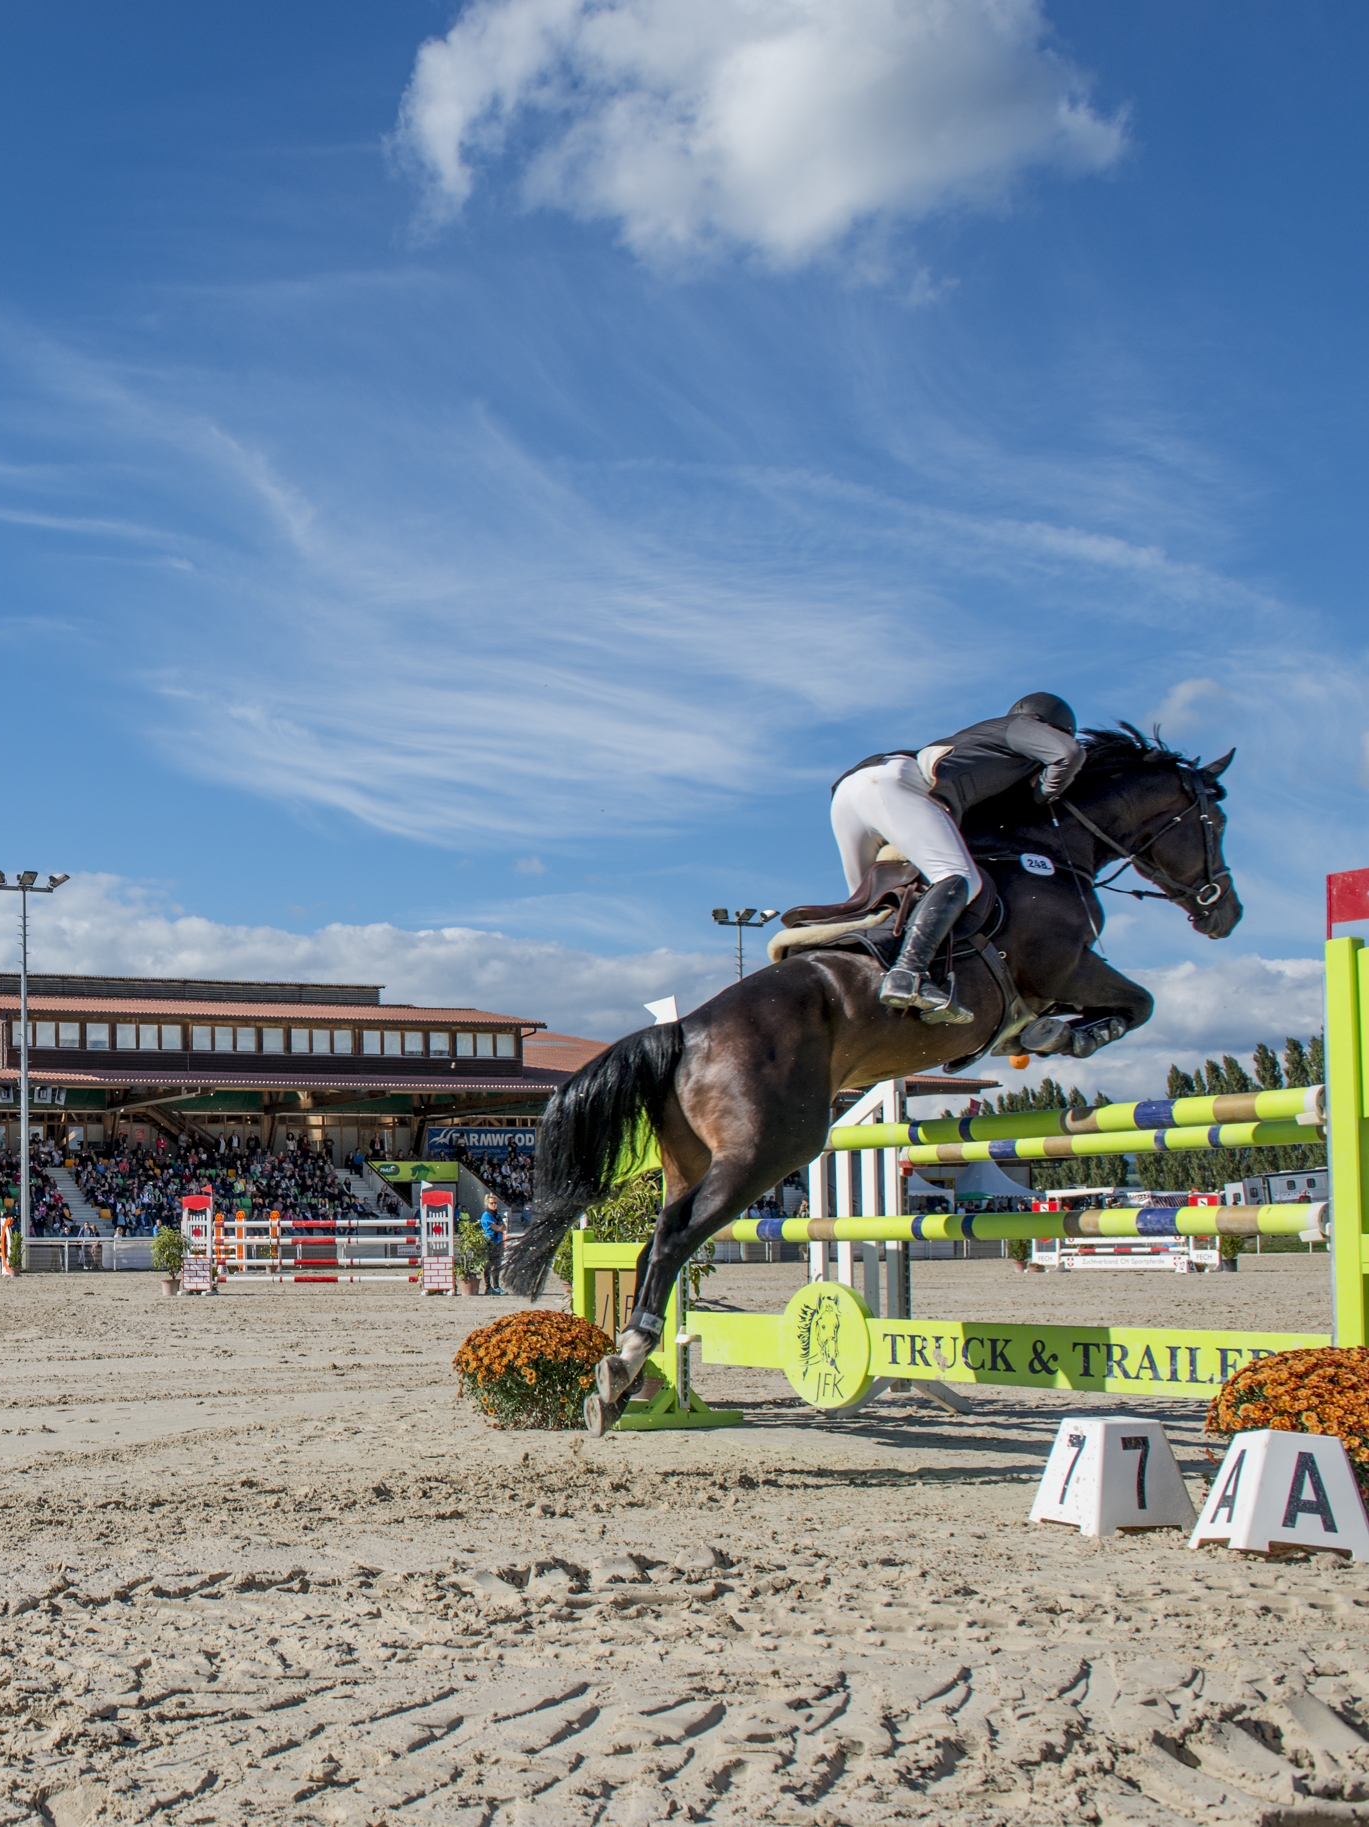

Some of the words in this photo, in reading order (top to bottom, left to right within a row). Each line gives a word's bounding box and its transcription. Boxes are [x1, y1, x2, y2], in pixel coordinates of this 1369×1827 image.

[1082, 1257, 1119, 1265] Zuchtverband
[882, 1333, 1017, 1373] TRUCK
[1028, 1339, 1059, 1376] &
[814, 1372, 845, 1403] JFK
[1058, 1433, 1087, 1506] 7
[1120, 1435, 1151, 1511] 7
[1209, 1448, 1248, 1524] A
[1282, 1451, 1339, 1534] A
